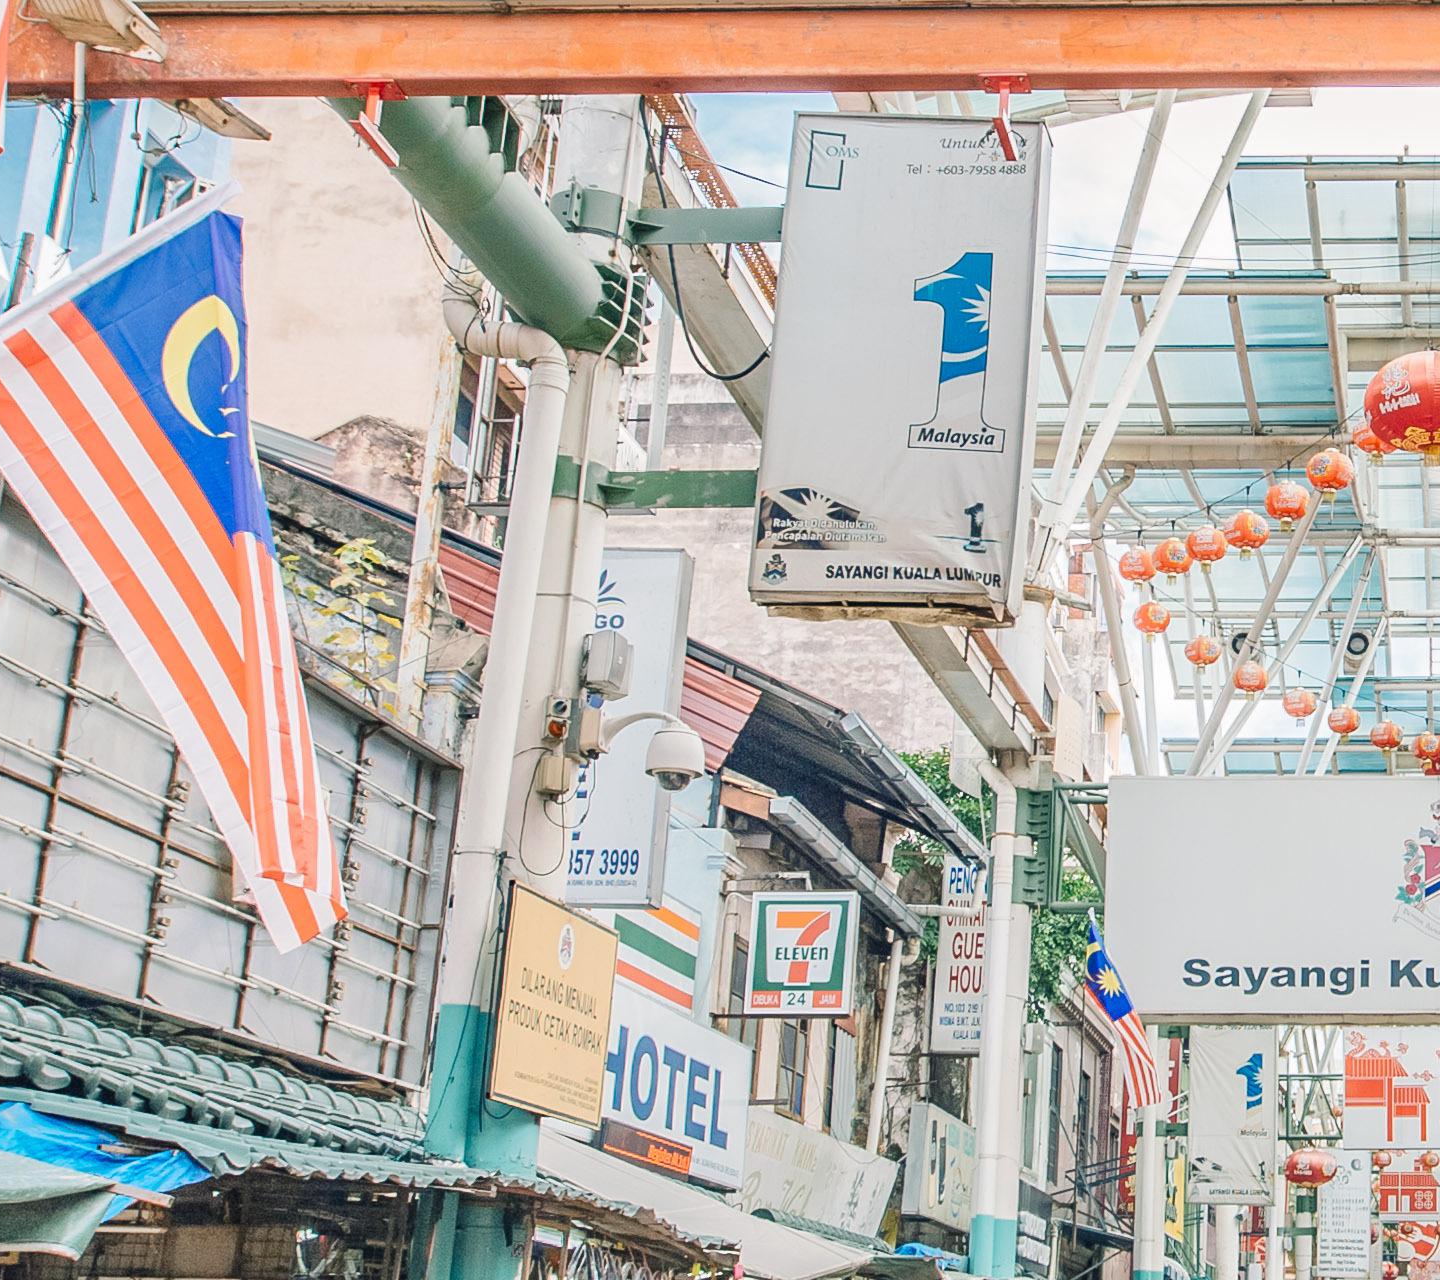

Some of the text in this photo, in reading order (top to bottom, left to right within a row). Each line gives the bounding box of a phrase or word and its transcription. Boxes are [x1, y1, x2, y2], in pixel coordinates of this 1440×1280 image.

[825, 145, 861, 159] OMS
[906, 163, 1027, 176] Tel +603-7958 4888
[916, 426, 996, 447] Malaysia
[772, 517, 809, 530] Rakyat
[825, 564, 1002, 589] SAYANGI KUALA LUMPUR
[598, 848, 640, 876] 3999
[776, 910, 831, 984] 7
[951, 931, 985, 960] GUE
[947, 964, 983, 994] HOU
[1182, 957, 1371, 996] Sayangi
[520, 966, 598, 1020] DILARANG MENJUAL
[786, 991, 806, 1007] 24
[817, 993, 836, 1006] JAM
[507, 999, 603, 1057] PRODUK CETAK ROMPAK
[606, 1023, 728, 1150] HOTEL
